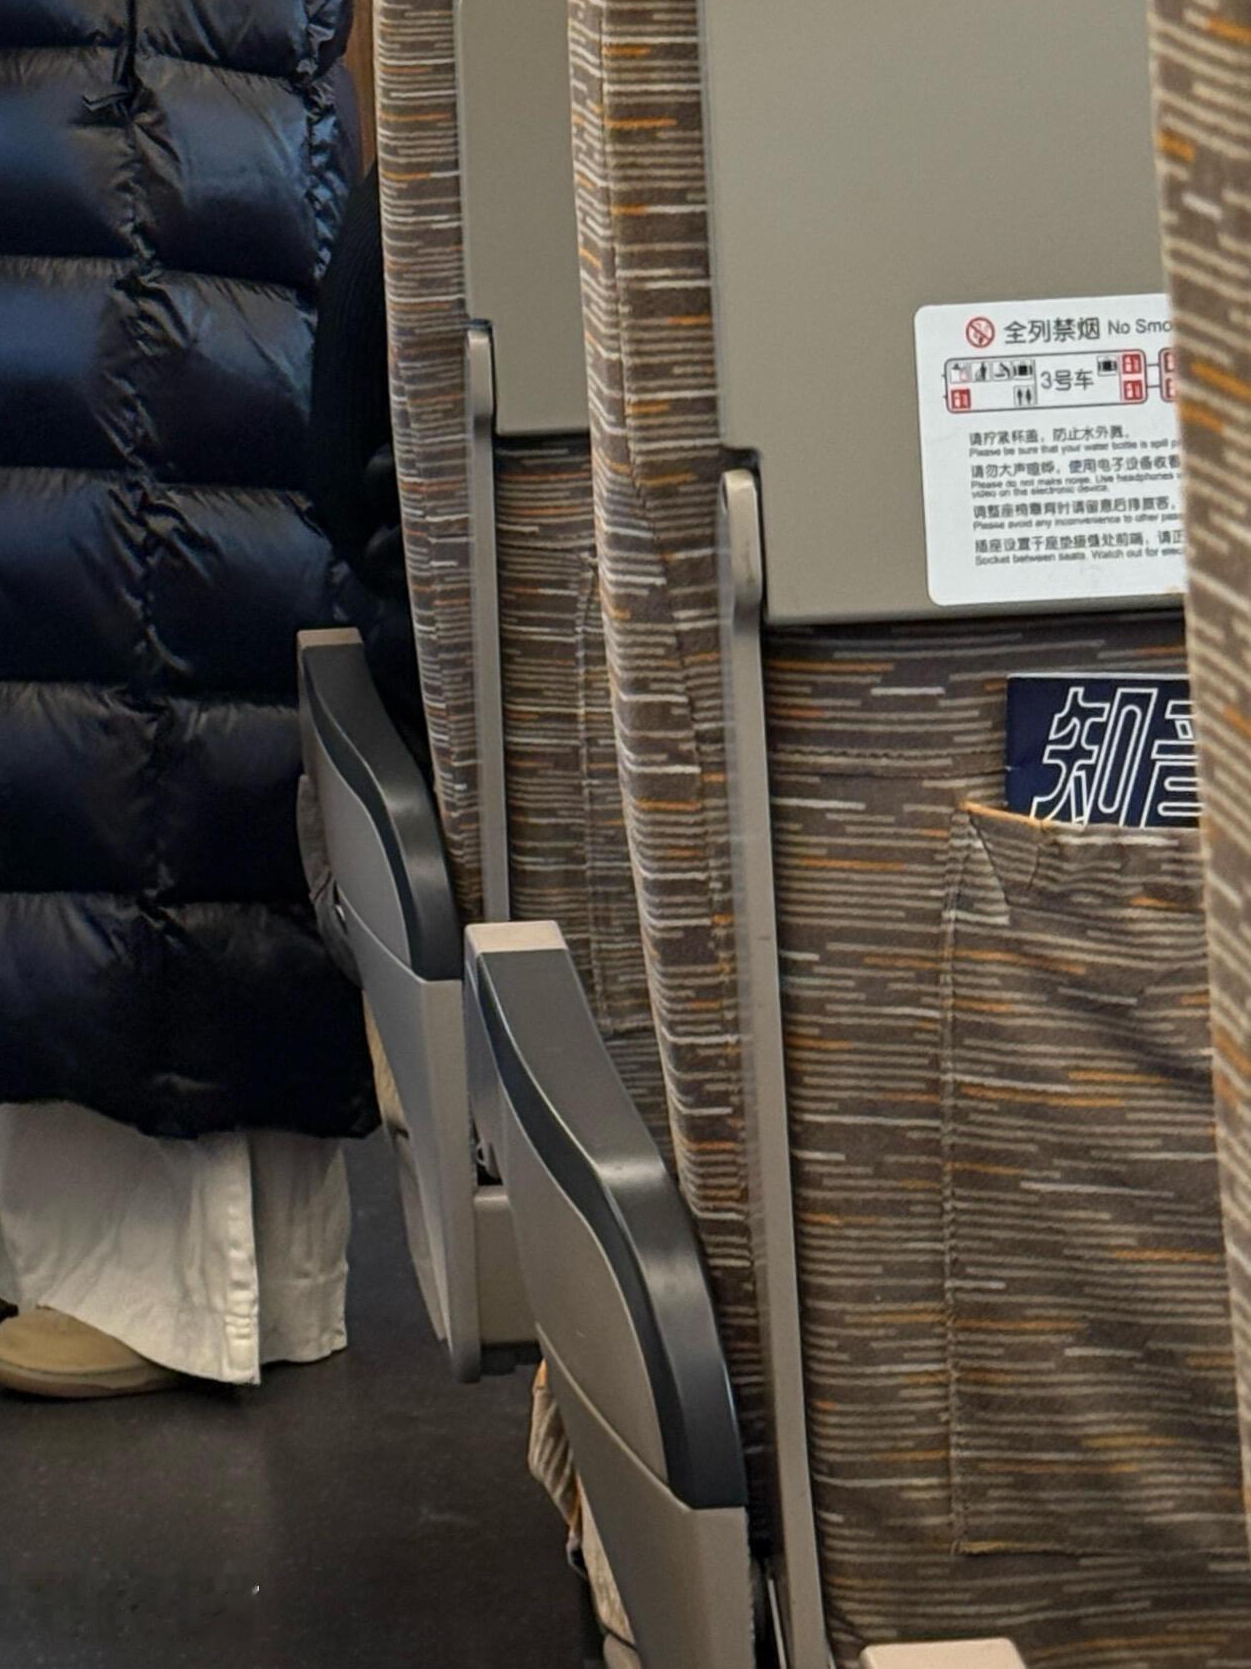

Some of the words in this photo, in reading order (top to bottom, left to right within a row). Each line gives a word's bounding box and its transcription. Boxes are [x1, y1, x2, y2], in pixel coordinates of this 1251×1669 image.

[1004, 317, 1100, 344] 全列禁烟
[1108, 320, 1131, 335] No
[1039, 368, 1094, 391] 3号车
